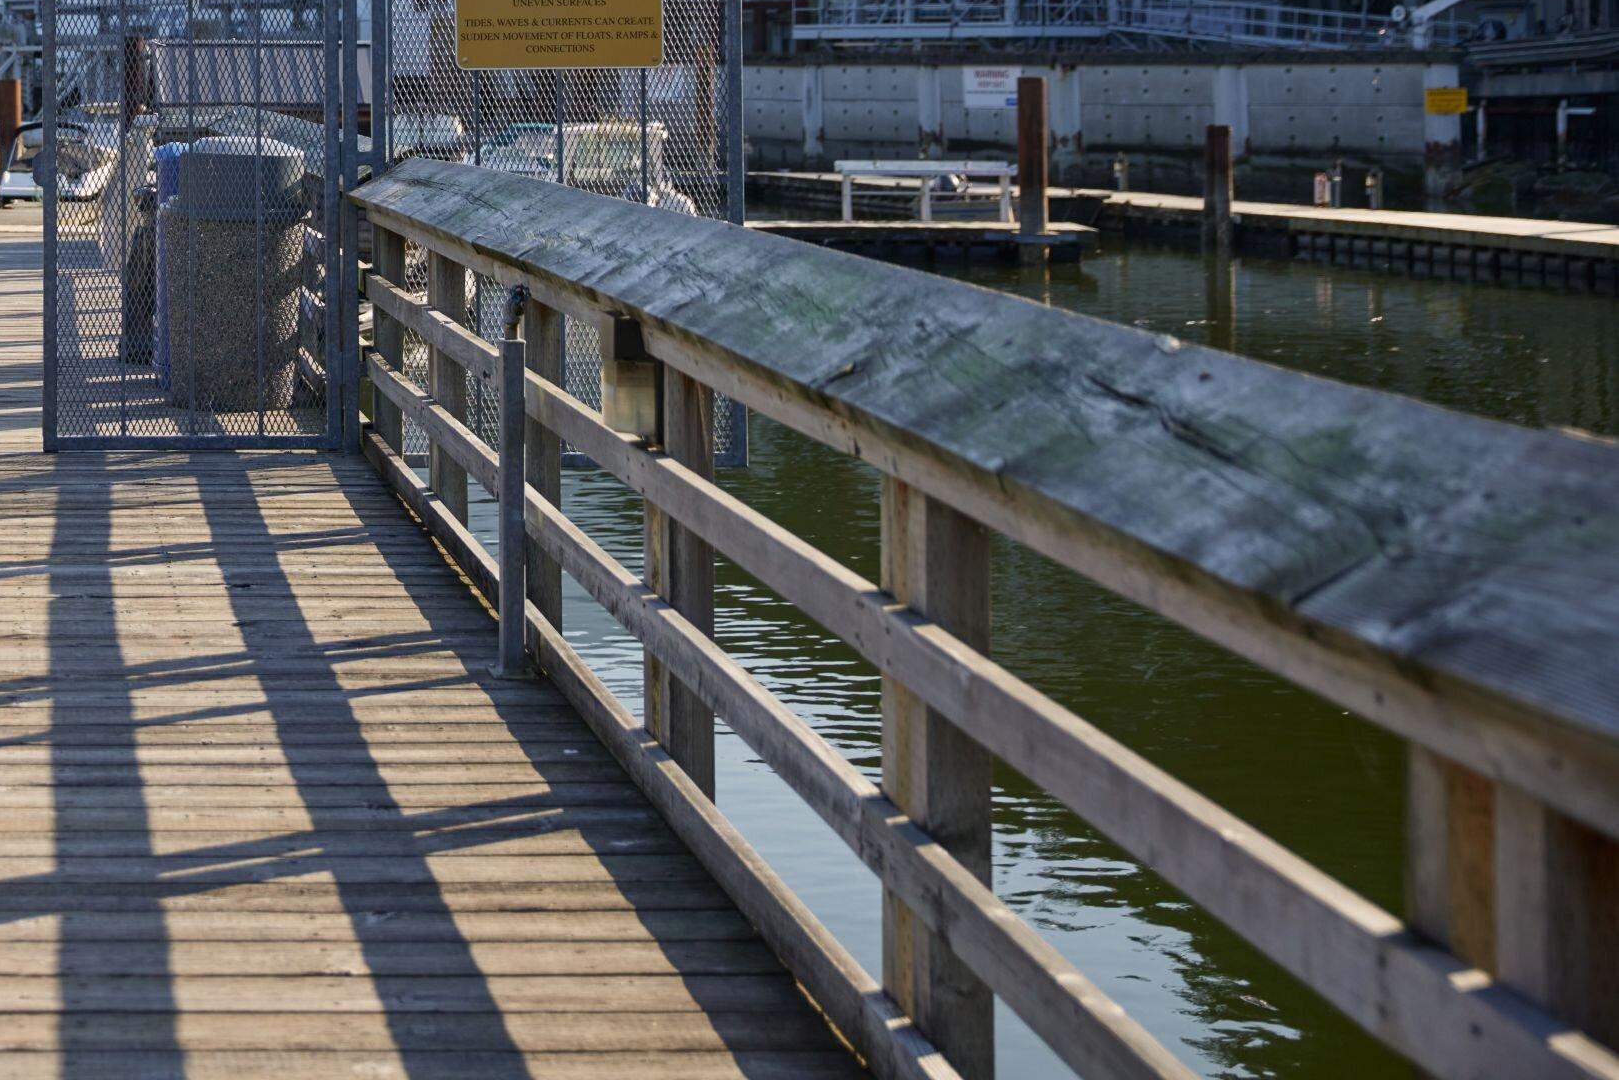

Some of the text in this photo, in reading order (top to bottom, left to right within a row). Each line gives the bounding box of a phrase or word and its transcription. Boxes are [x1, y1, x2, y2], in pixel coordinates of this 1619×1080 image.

[497, 18, 530, 27] WAVES
[532, 18, 540, 27] &
[542, 17, 593, 26] CURRENTS
[595, 17, 615, 26] CAN
[618, 17, 655, 26] CREATE
[461, 32, 500, 41] SUDDEN
[503, 32, 559, 41] MOVEMENT
[561, 31, 574, 40] OF
[617, 31, 649, 40] RAMPS
[651, 30, 659, 39] &
[526, 45, 596, 54] CONNECTIONS
